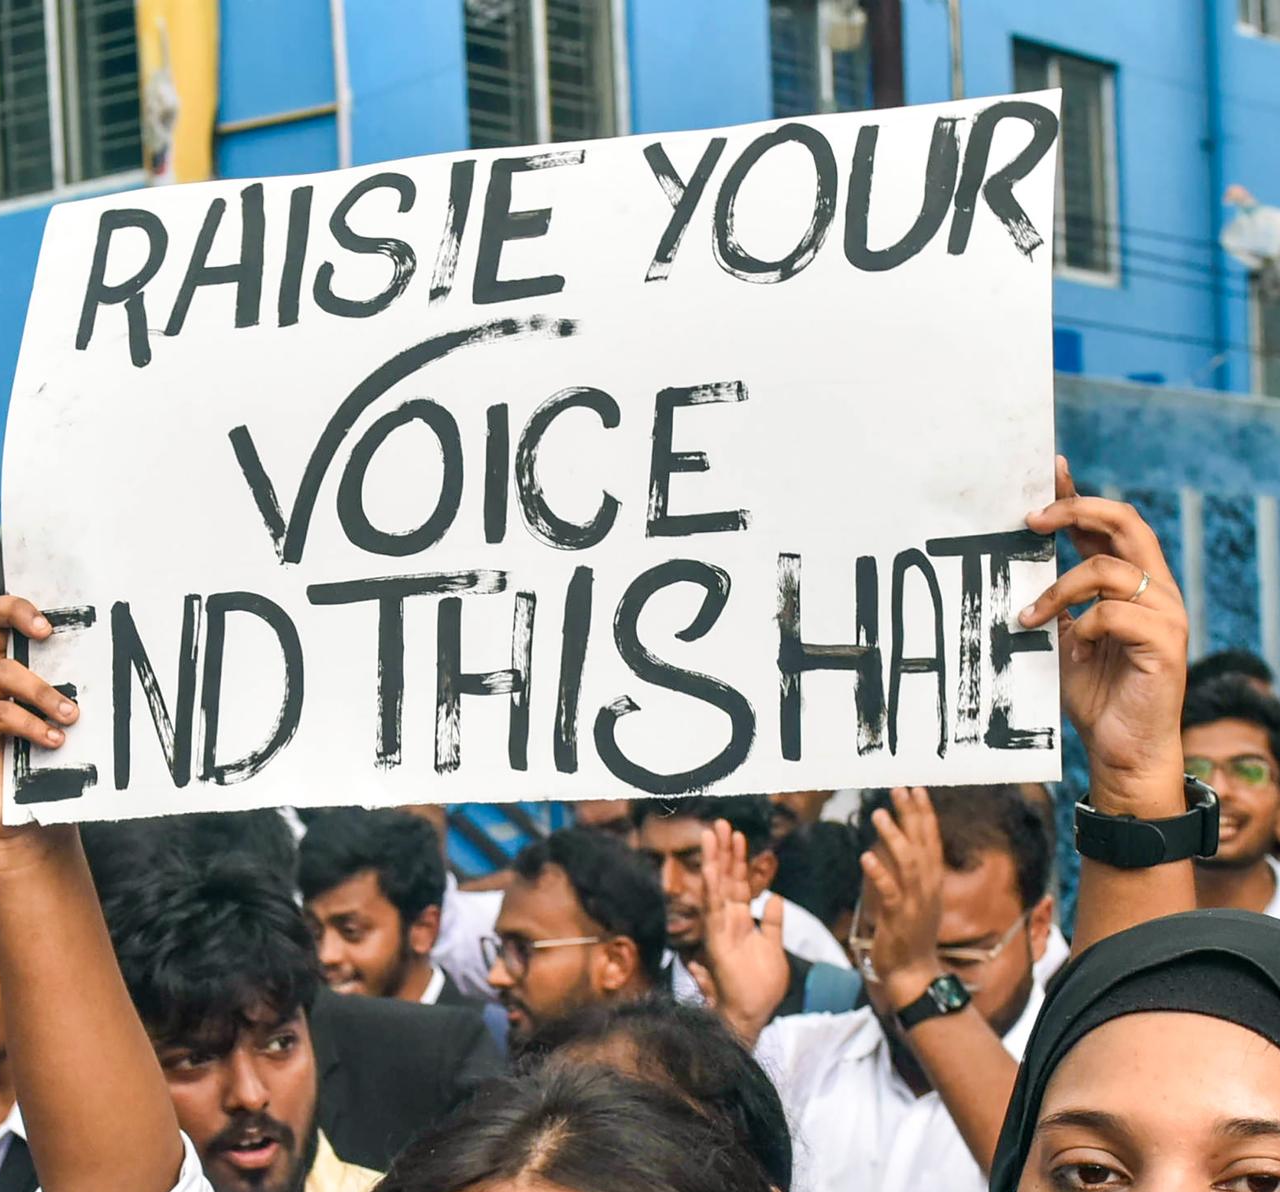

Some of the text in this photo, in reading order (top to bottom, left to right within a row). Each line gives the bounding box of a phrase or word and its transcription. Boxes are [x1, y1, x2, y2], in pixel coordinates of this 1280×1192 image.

[644, 100, 1060, 284] YOUR
[228, 317, 750, 565] VOICE
[11, 529, 1056, 801] END THIS HATE
